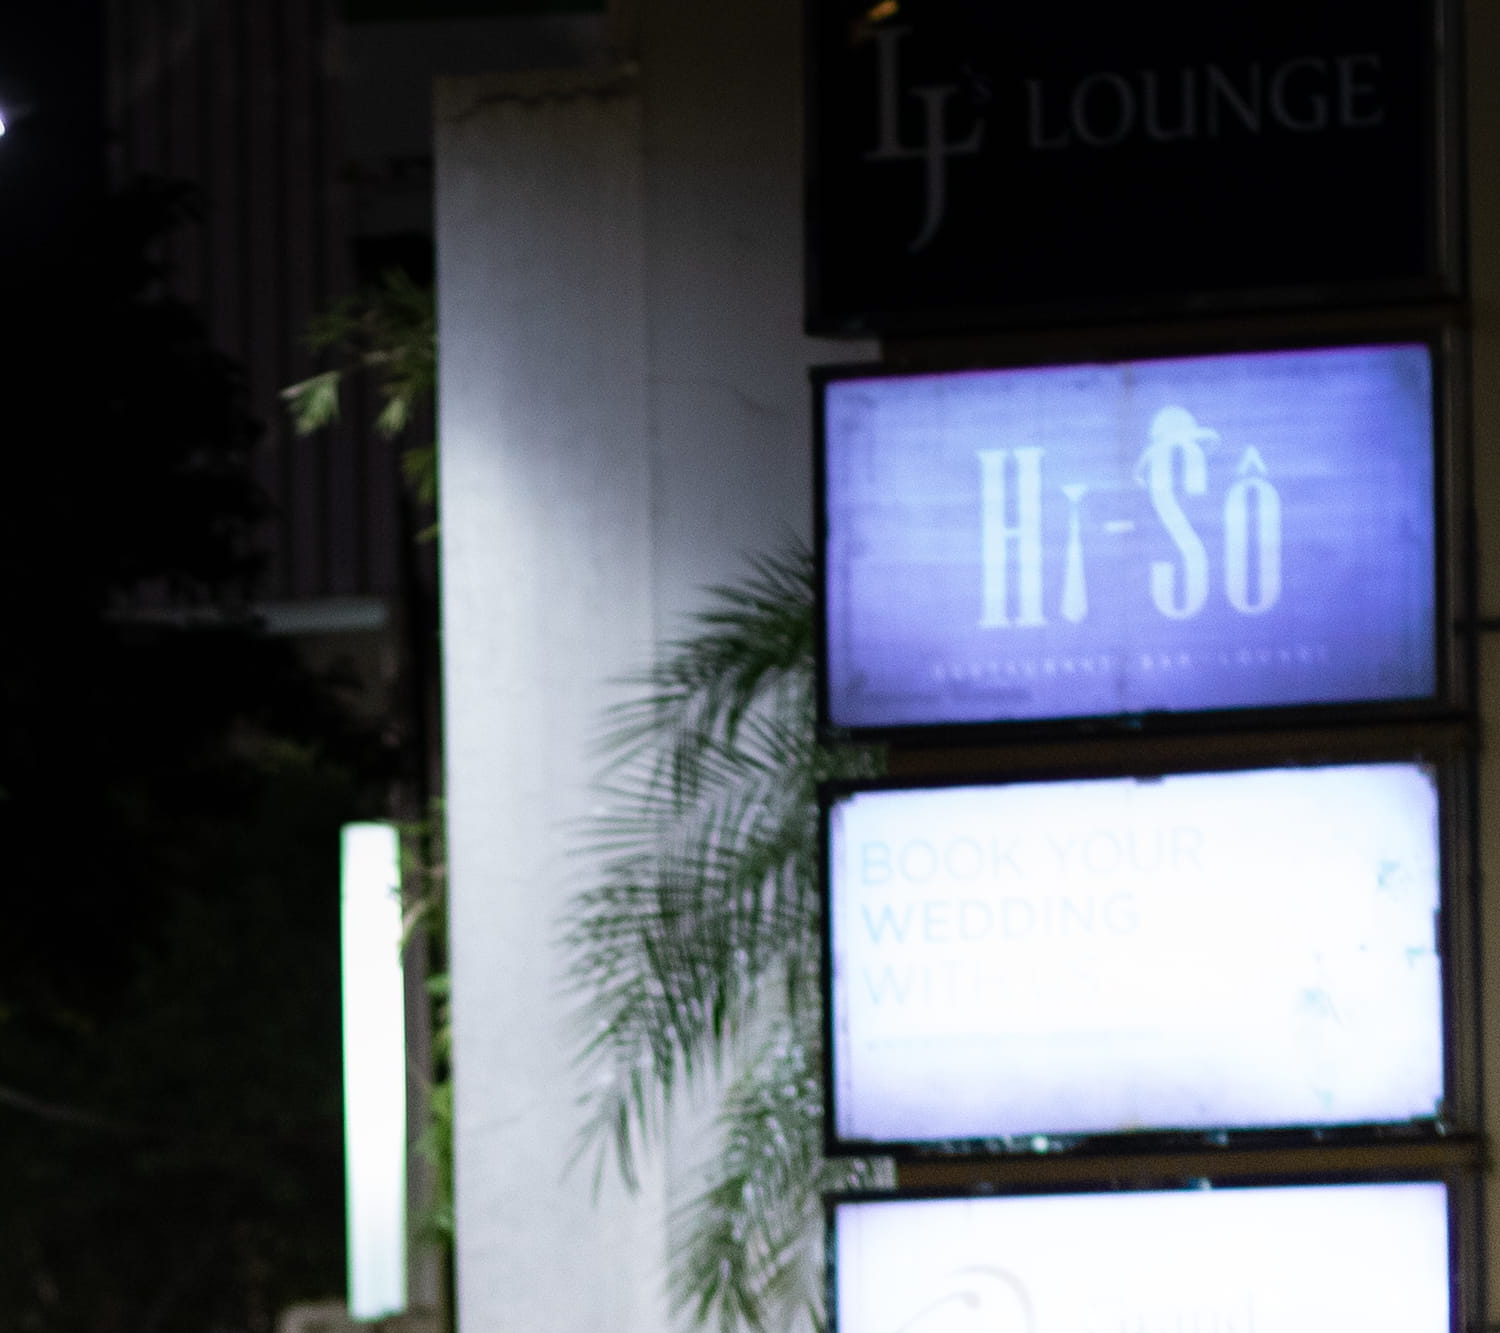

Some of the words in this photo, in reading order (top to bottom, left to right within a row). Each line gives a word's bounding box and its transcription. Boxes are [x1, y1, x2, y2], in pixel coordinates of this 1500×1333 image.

[1022, 53, 1385, 151] LOUNGE
[859, 835, 1024, 887] BOOK
[1045, 824, 1207, 877] YOUR
[860, 891, 1142, 947] WEDDING
[861, 957, 1006, 1009] WITH
